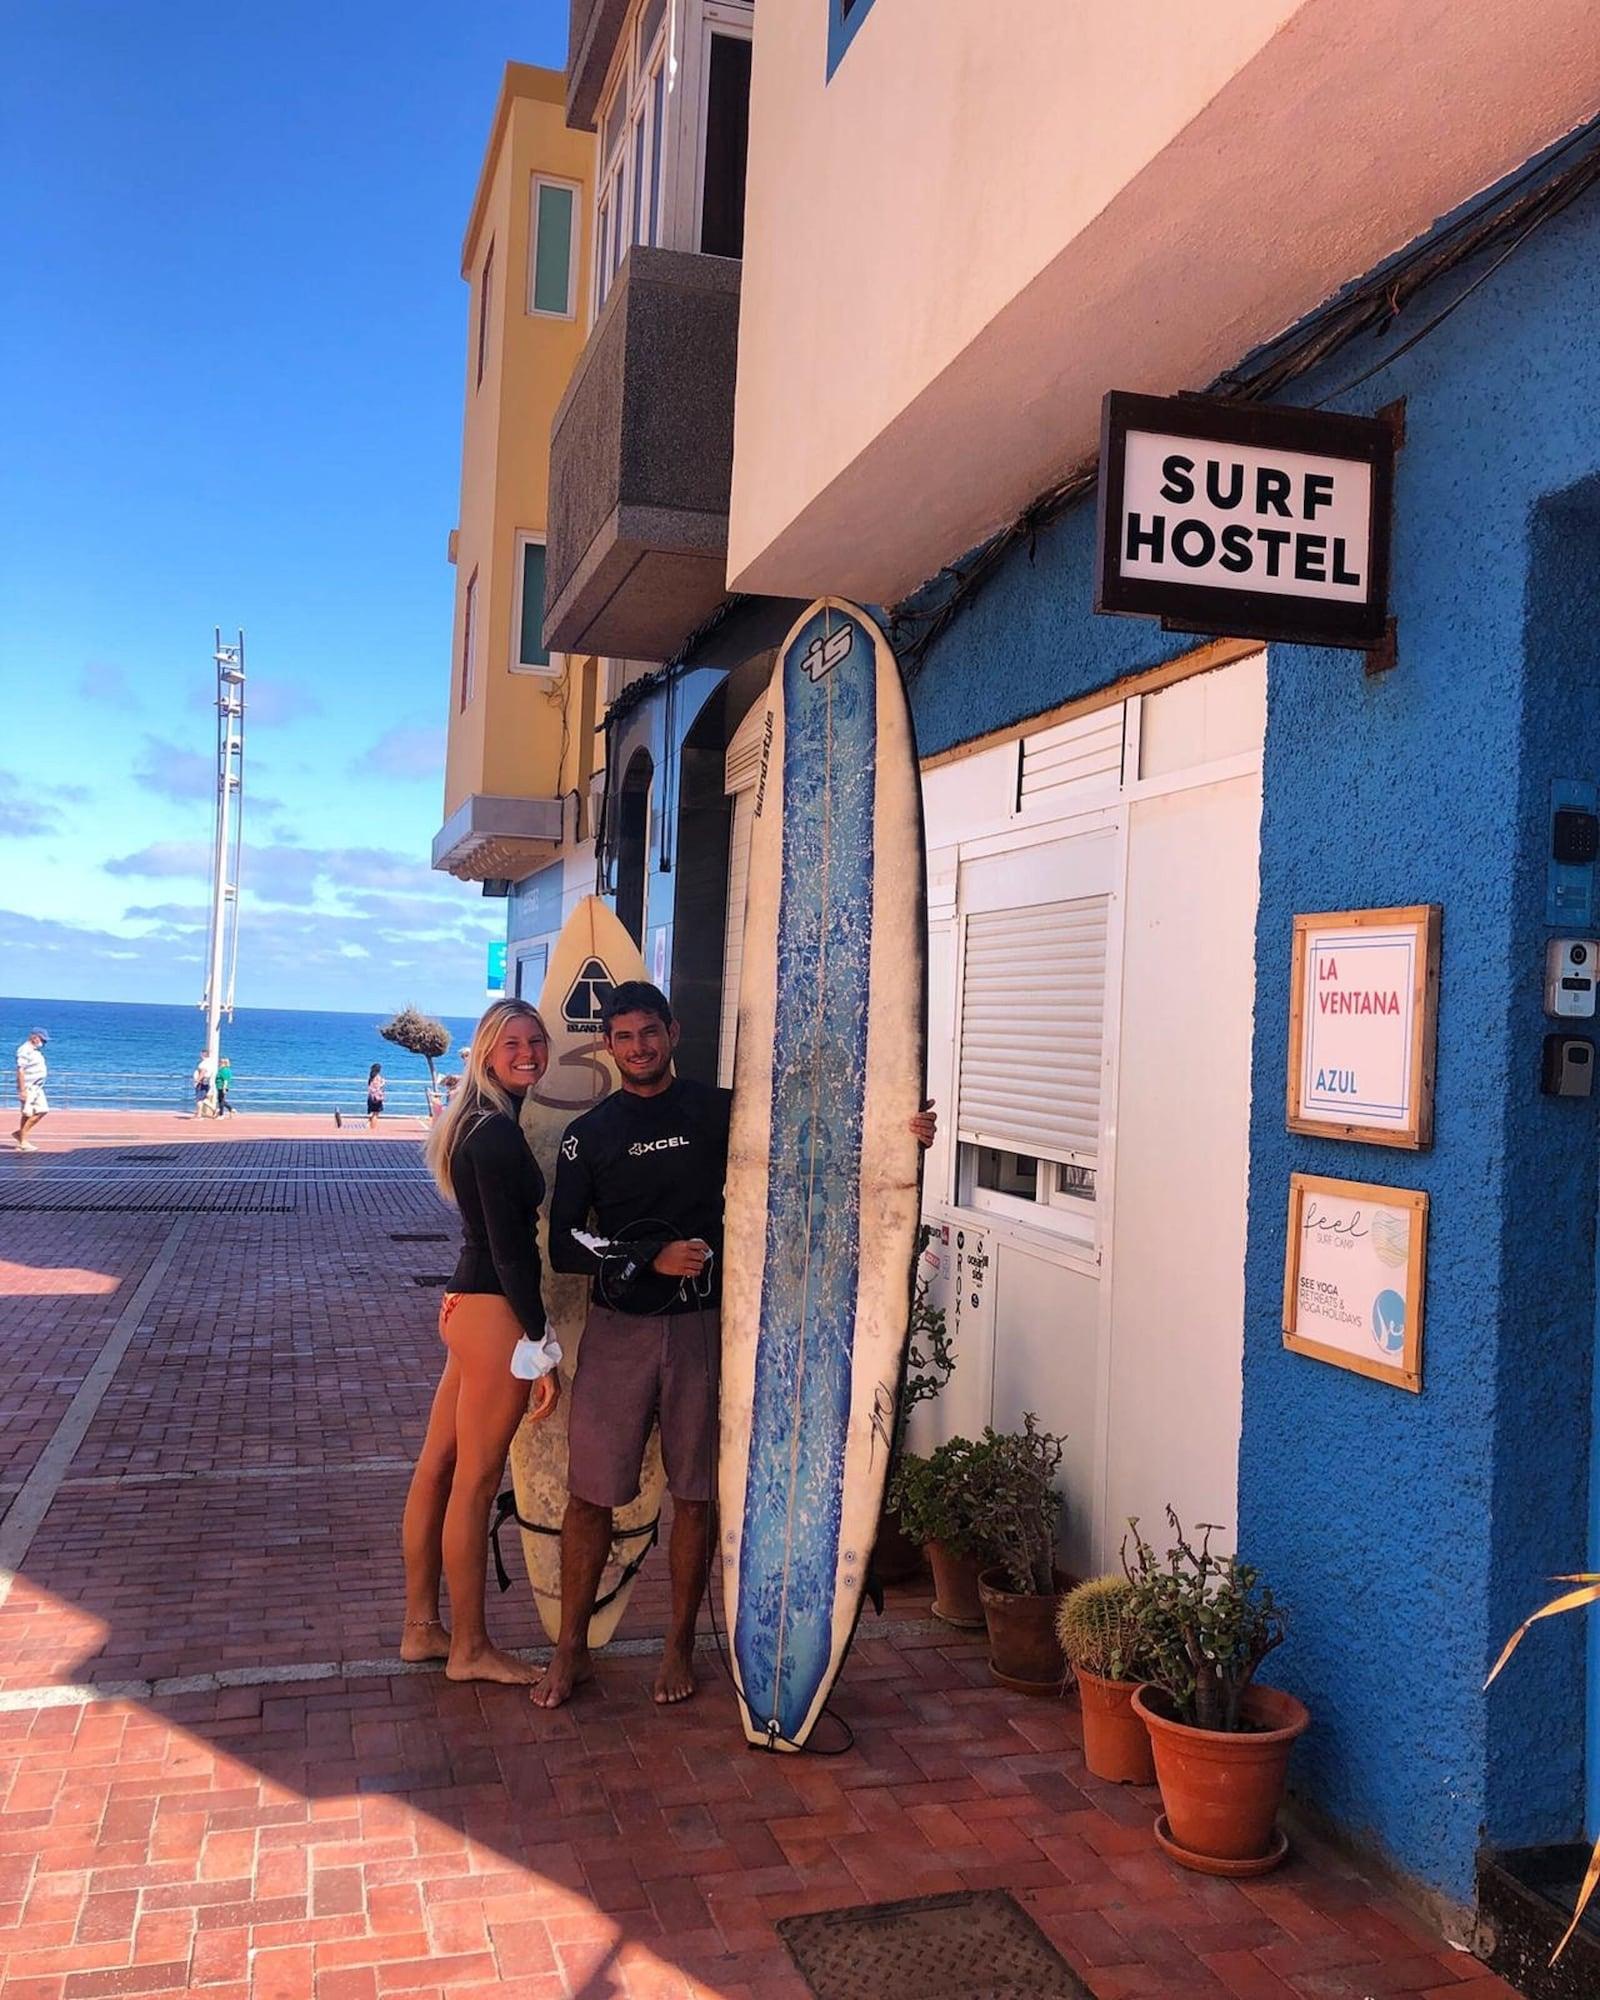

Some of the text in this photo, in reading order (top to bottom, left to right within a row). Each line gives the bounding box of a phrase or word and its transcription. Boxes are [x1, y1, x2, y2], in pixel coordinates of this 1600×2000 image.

[1160, 455, 1334, 521] SURF
[1126, 512, 1361, 586] HOSTEL
[1319, 957, 1338, 981] LA
[1319, 990, 1400, 1015] VENTANA
[1315, 1068, 1357, 1094] AZUL
[1303, 1202, 1369, 1239] feel
[1300, 1276, 1338, 1295] SEE YOGA
[1322, 1306, 1362, 1328] HOLIDAYS
